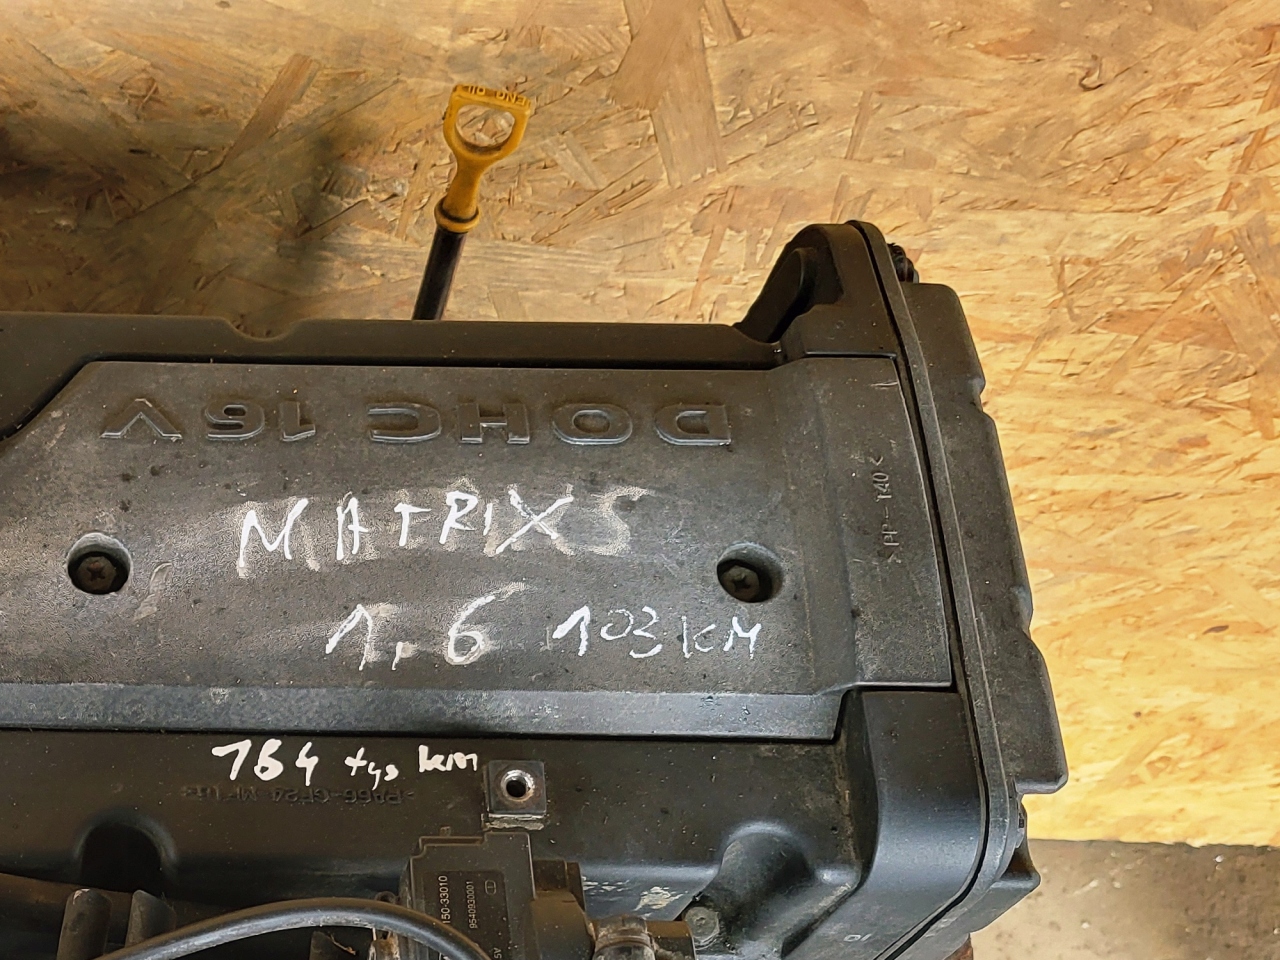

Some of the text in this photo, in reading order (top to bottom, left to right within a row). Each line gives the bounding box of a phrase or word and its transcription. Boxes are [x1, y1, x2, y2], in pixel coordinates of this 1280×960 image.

[100, 398, 731, 446] DOHC 16V
[212, 739, 320, 786] 164
